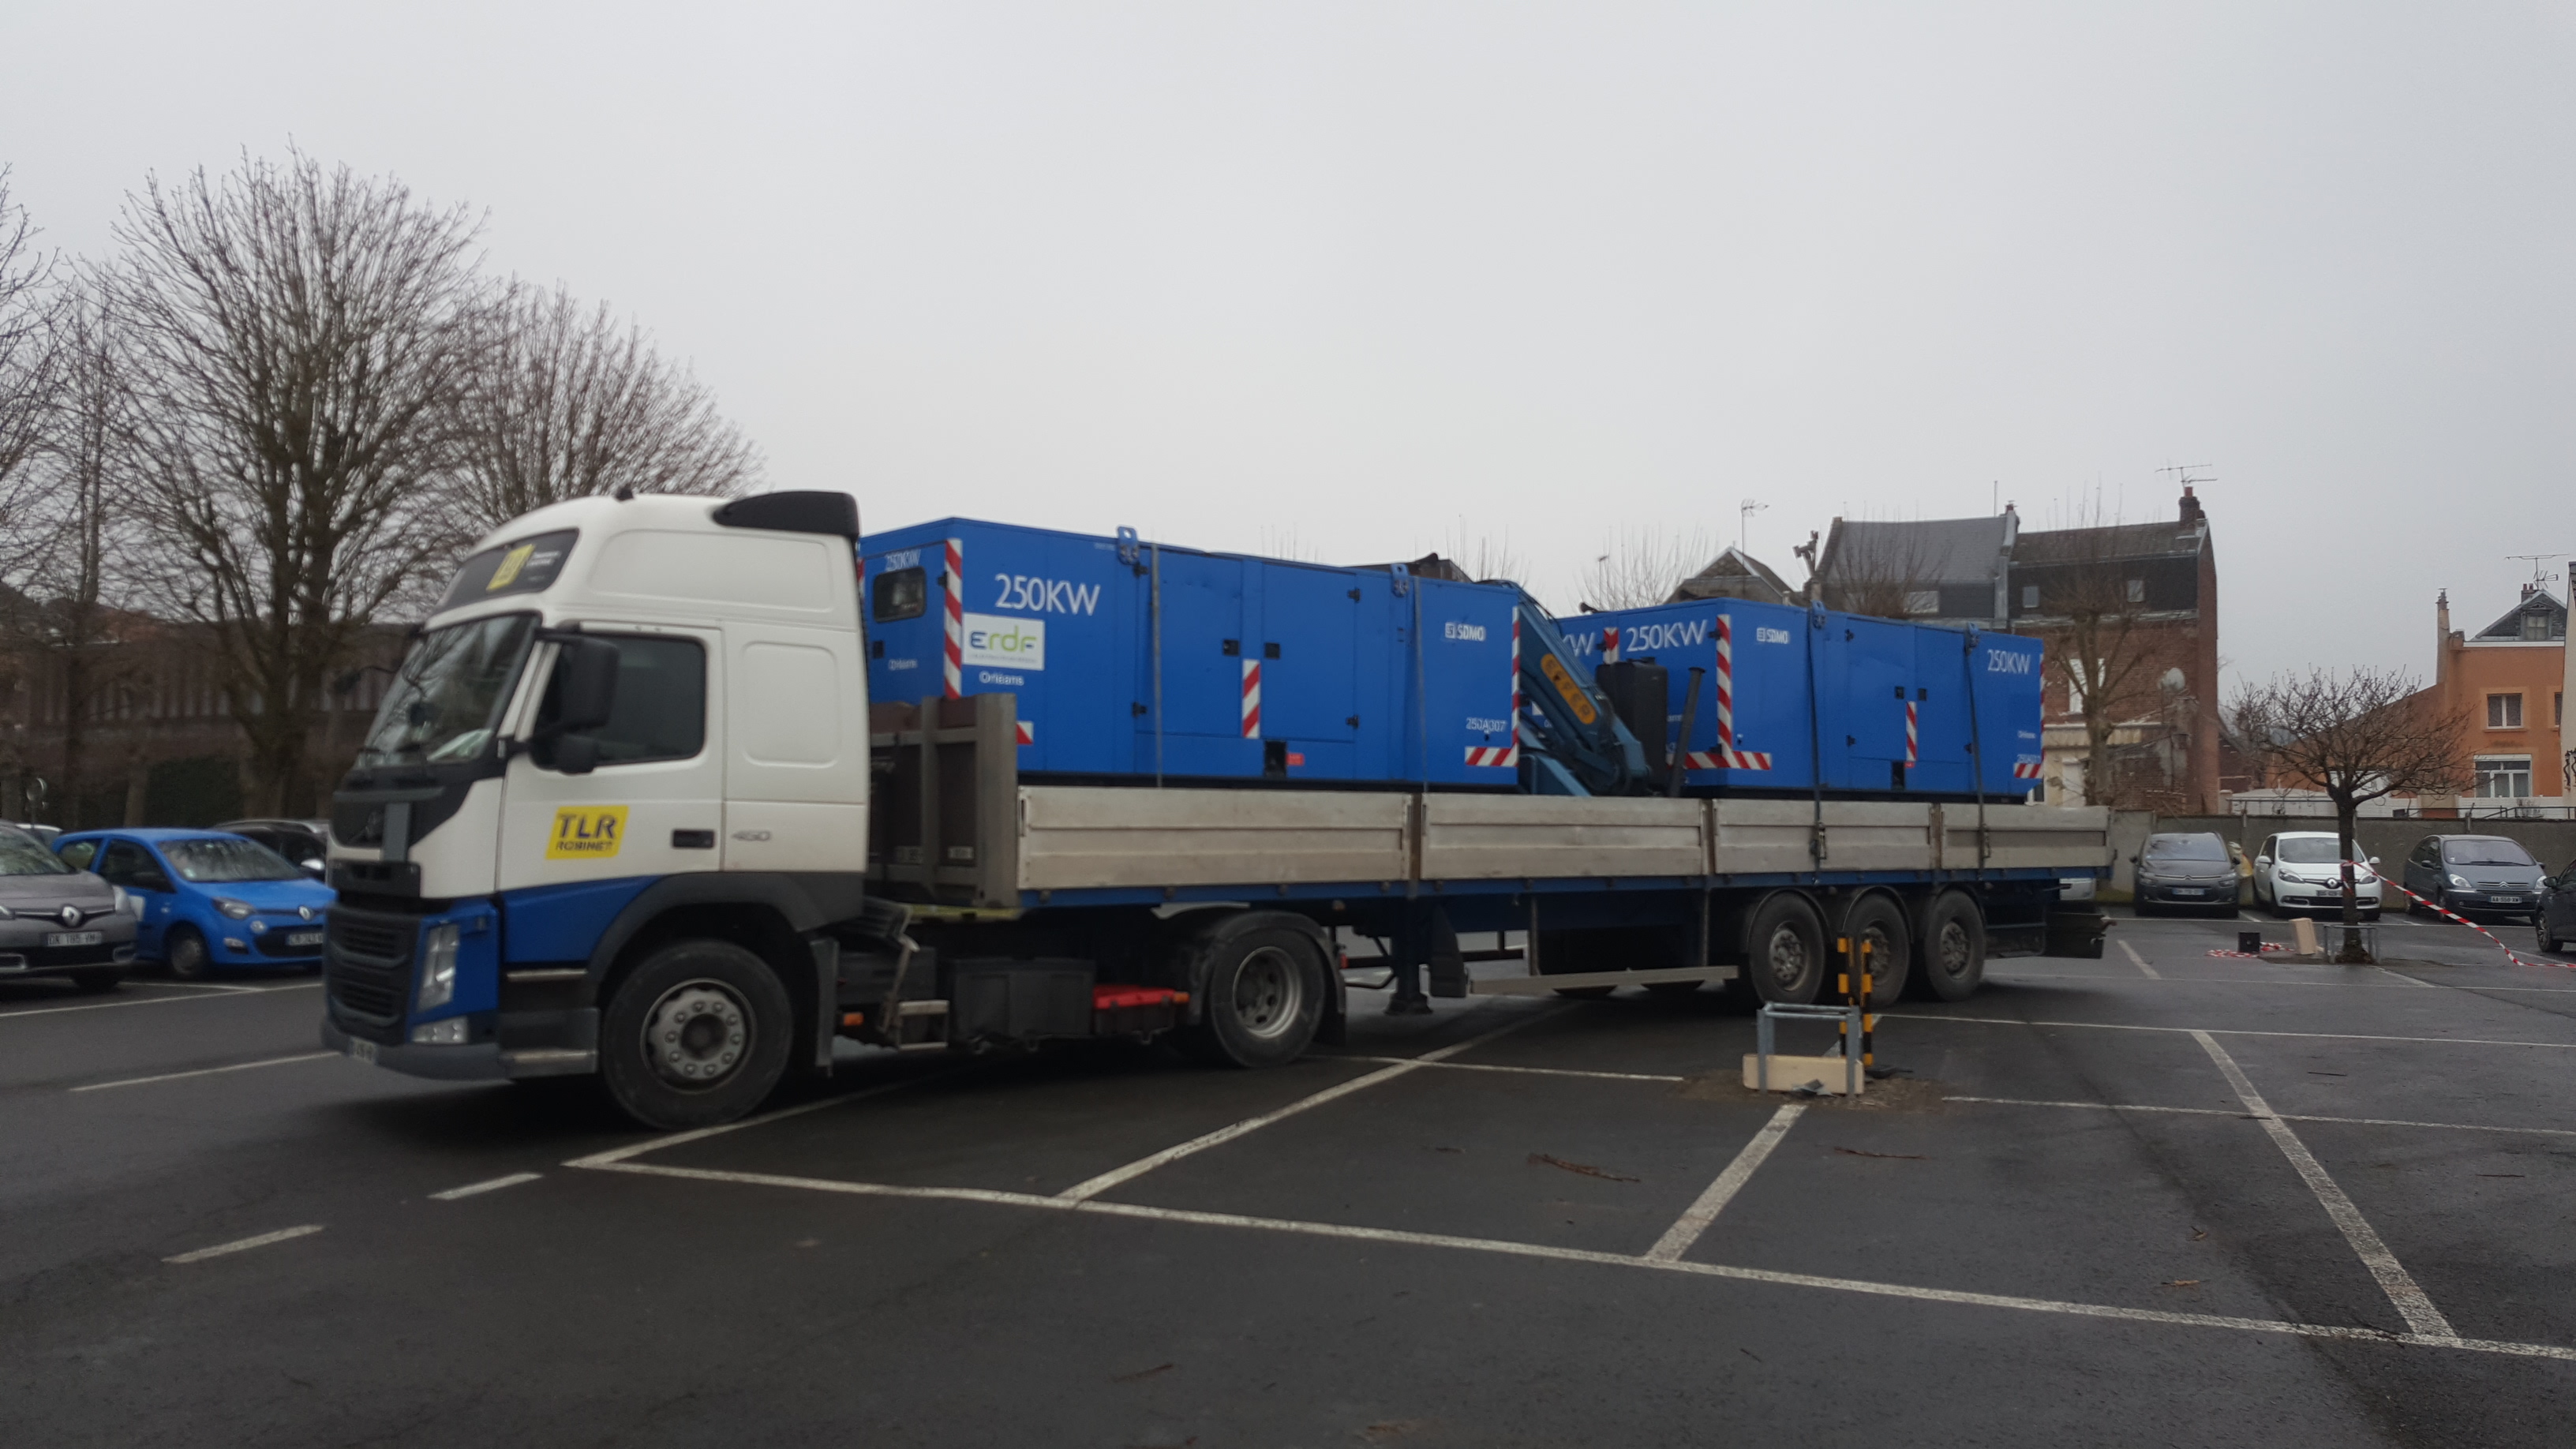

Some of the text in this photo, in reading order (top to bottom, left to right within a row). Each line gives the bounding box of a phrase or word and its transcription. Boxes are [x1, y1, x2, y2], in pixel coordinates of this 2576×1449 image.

[885, 549, 922, 571] 250KW
[994, 573, 1101, 616] 250KW
[1456, 623, 1486, 642] SDMO
[1626, 619, 1708, 652] 250KW
[1987, 649, 2031, 675] 250KW
[979, 671, 1024, 686] Orléans
[557, 814, 617, 839] TLR
[556, 841, 613, 852] ROBINET
